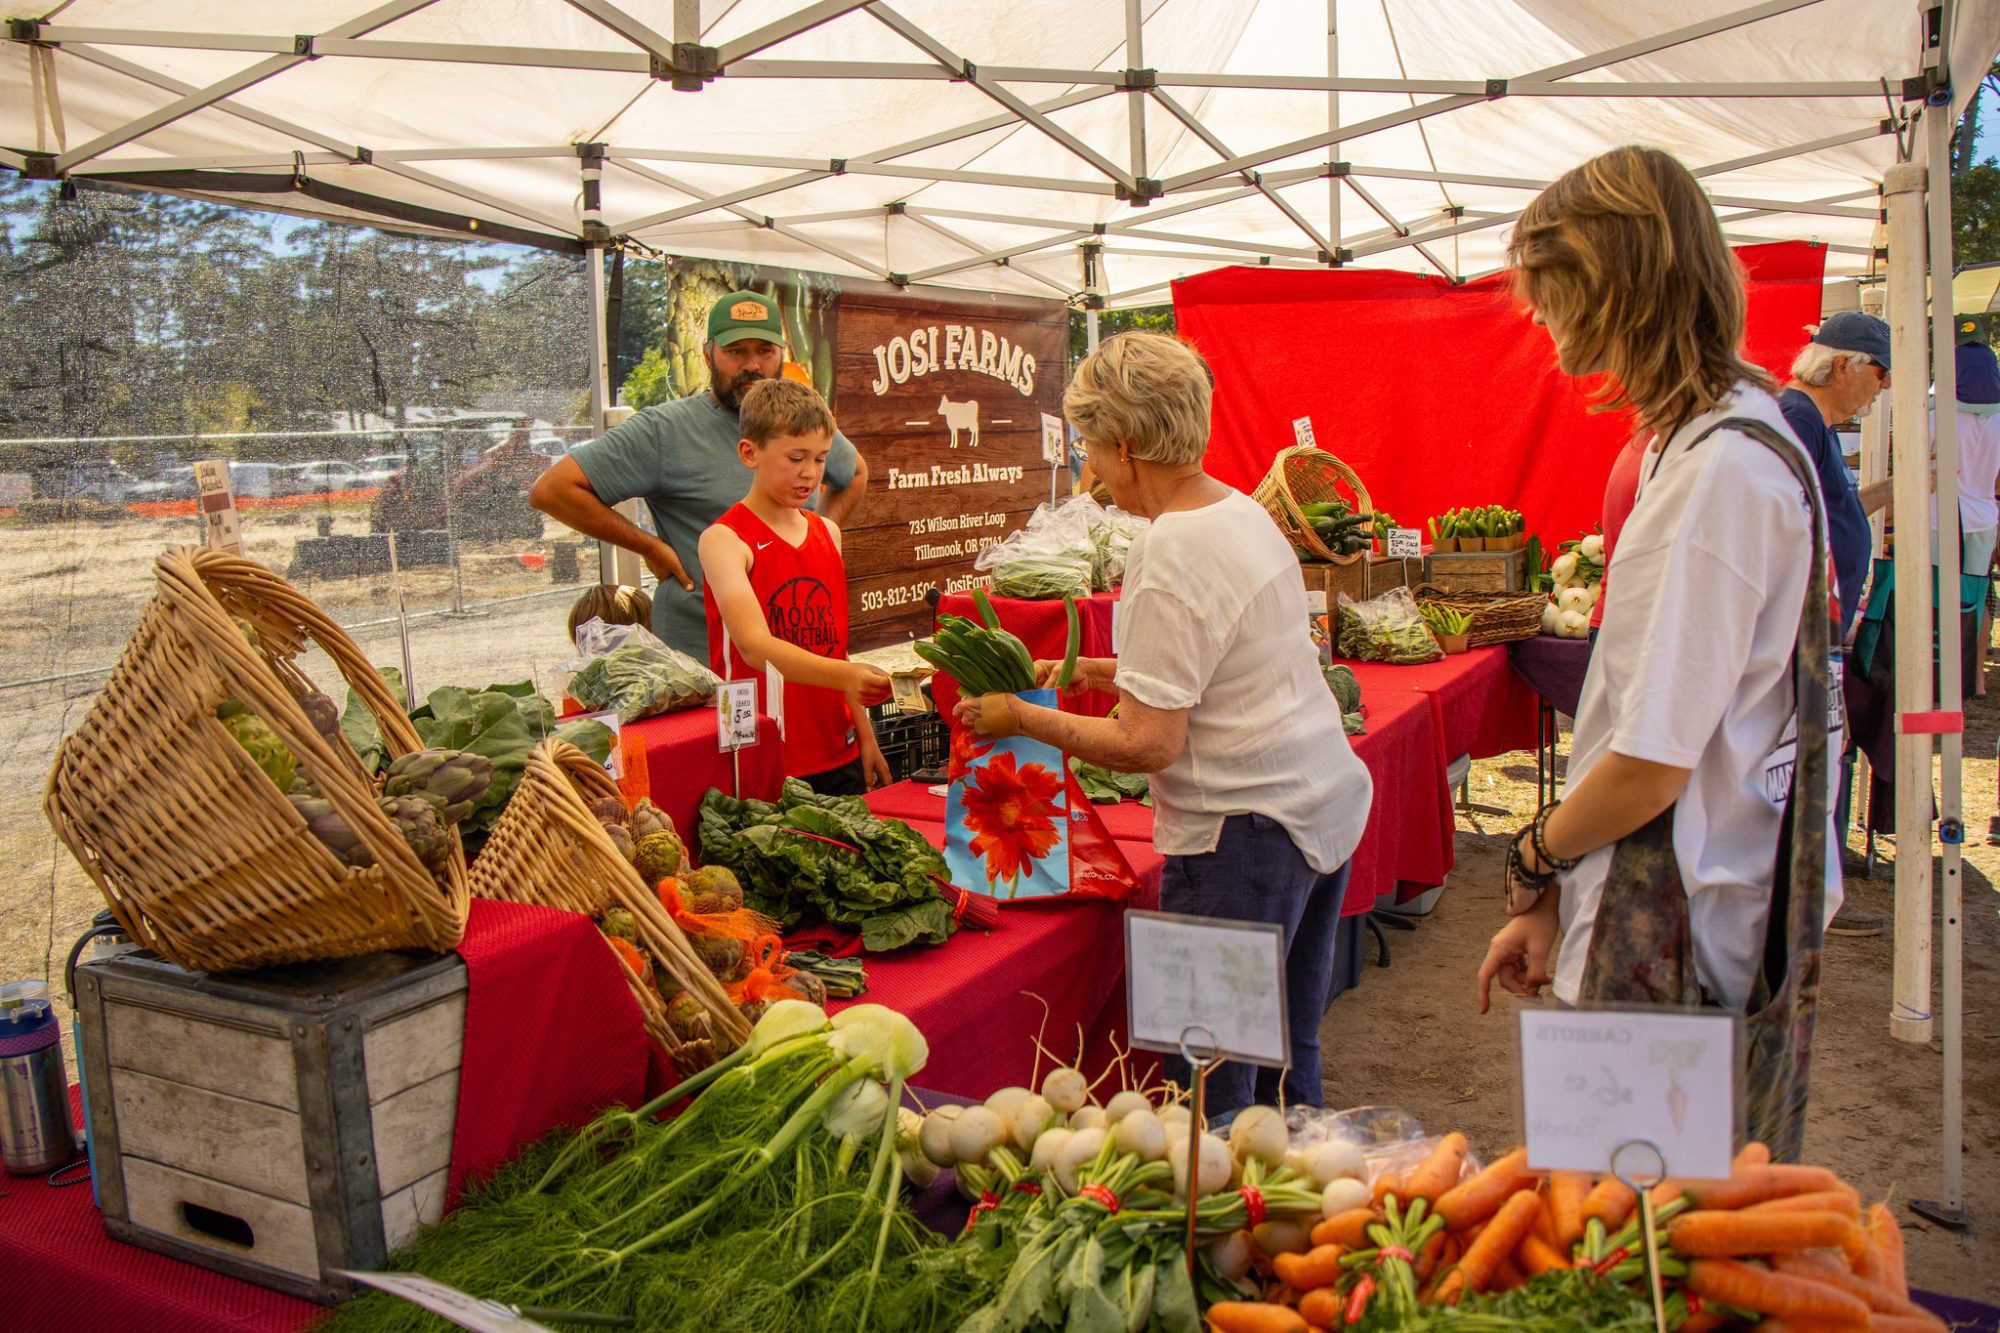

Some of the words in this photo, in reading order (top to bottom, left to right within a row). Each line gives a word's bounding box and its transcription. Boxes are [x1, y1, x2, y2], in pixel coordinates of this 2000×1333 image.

[872, 326, 940, 396] JOSI
[944, 325, 1036, 396] FARMS
[888, 467, 929, 490] Farm
[931, 464, 971, 486] Fresh
[972, 463, 1023, 484] Always
[909, 519, 926, 535] 735
[927, 516, 958, 532] Wilson
[960, 513, 984, 528] River
[984, 512, 1006, 527] Loop
[914, 540, 964, 560] Tillamook,
[965, 538, 978, 553] OR
[769, 605, 835, 628] MOOKS
[774, 626, 840, 647] ASKETBALL
